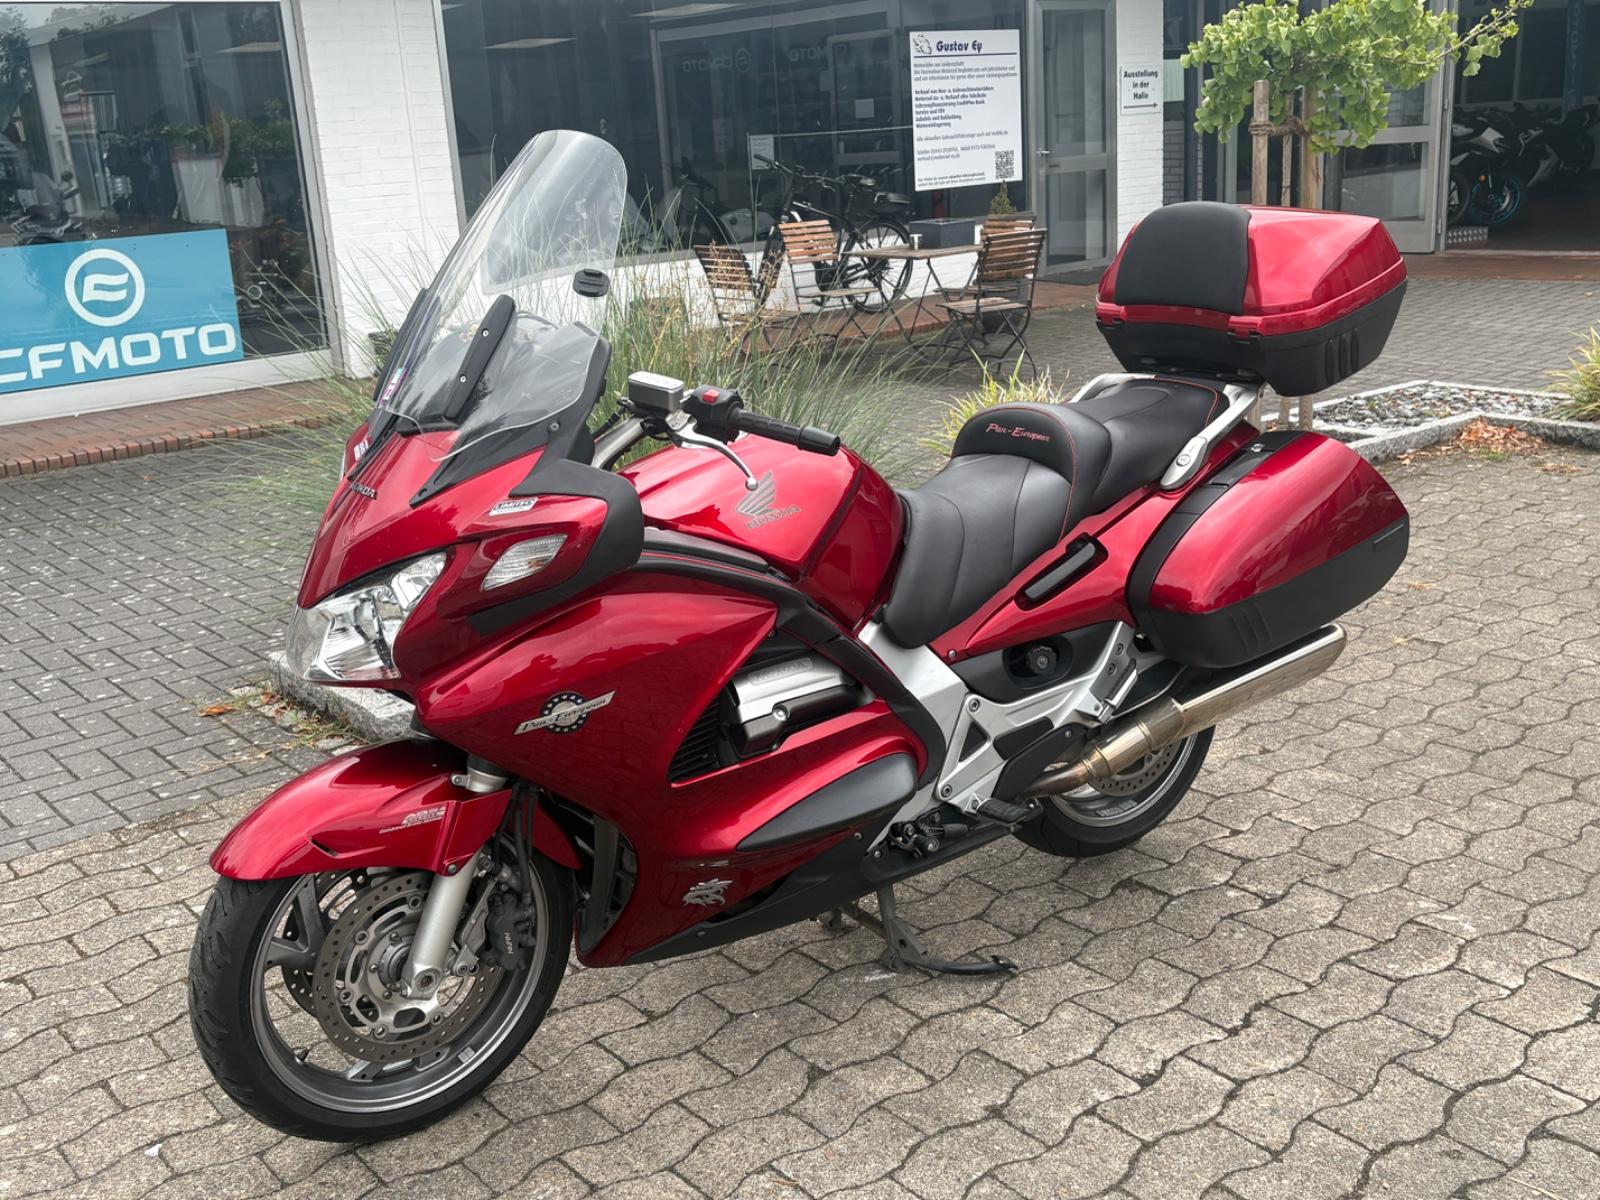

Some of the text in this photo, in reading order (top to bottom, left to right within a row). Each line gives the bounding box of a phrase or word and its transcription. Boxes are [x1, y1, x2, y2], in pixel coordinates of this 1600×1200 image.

[936, 40, 982, 54] Gustav Ey
[1124, 70, 1158, 78] Ausstellung
[1139, 80, 1150, 88] der
[1134, 92, 1149, 100] Halle
